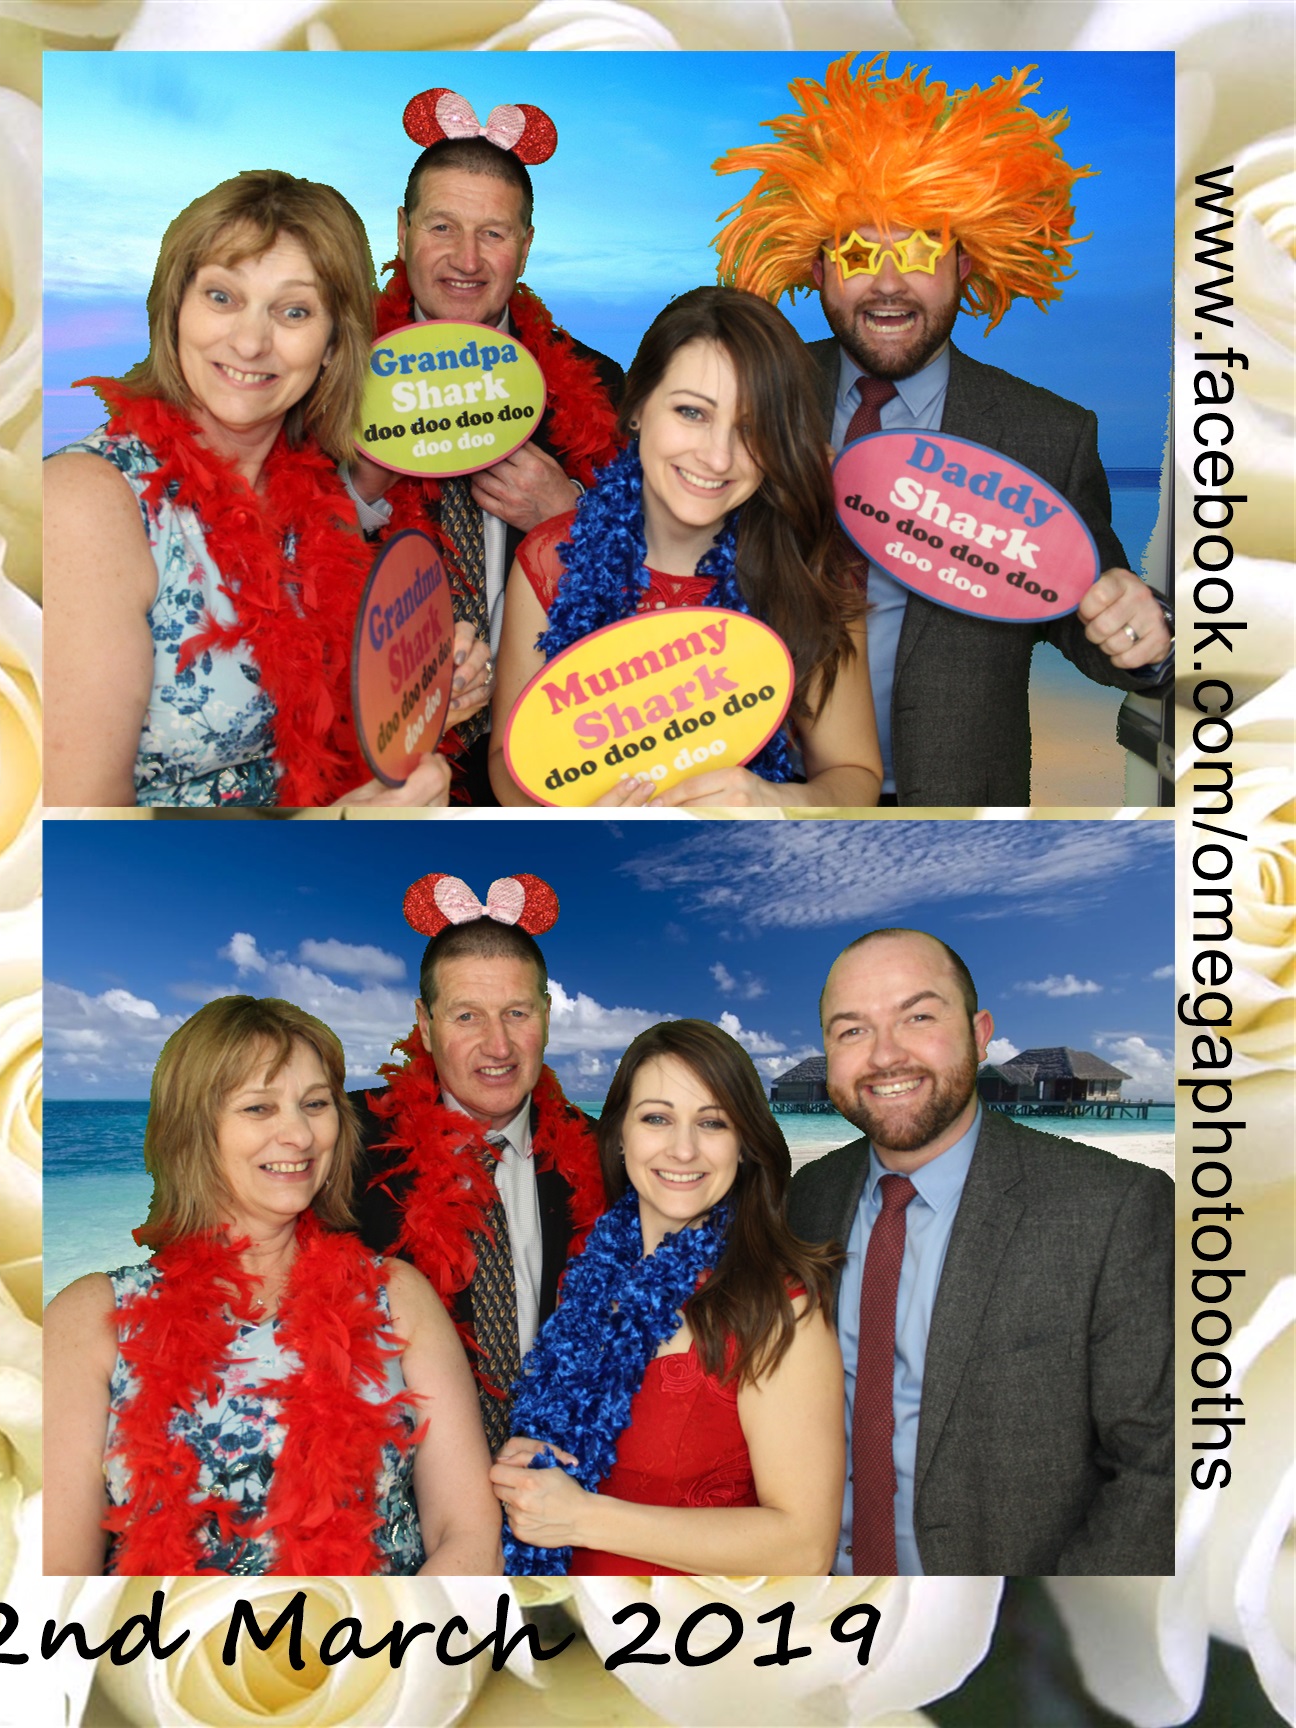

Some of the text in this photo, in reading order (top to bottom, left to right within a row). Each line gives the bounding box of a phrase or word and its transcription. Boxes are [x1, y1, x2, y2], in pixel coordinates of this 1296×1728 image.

[370, 341, 519, 377] Grandpa
[392, 372, 510, 413] Shark
[364, 405, 534, 442] doo doo doo doo
[412, 432, 495, 458] doo doo
[889, 477, 1040, 569] Shark
[905, 437, 1062, 528] Daddy
[844, 494, 1058, 602] doo doo doo doo
[885, 542, 987, 598] doo doo
[369, 559, 442, 652] Grandma
[388, 603, 442, 695] Shark
[377, 637, 451, 754] doo doo doo doo
[541, 619, 729, 715] Mummy
[573, 664, 740, 750] Shark
[404, 688, 442, 754] doo doo
[545, 685, 775, 790] doo doo doo doo
[620, 739, 727, 783] oo doo
